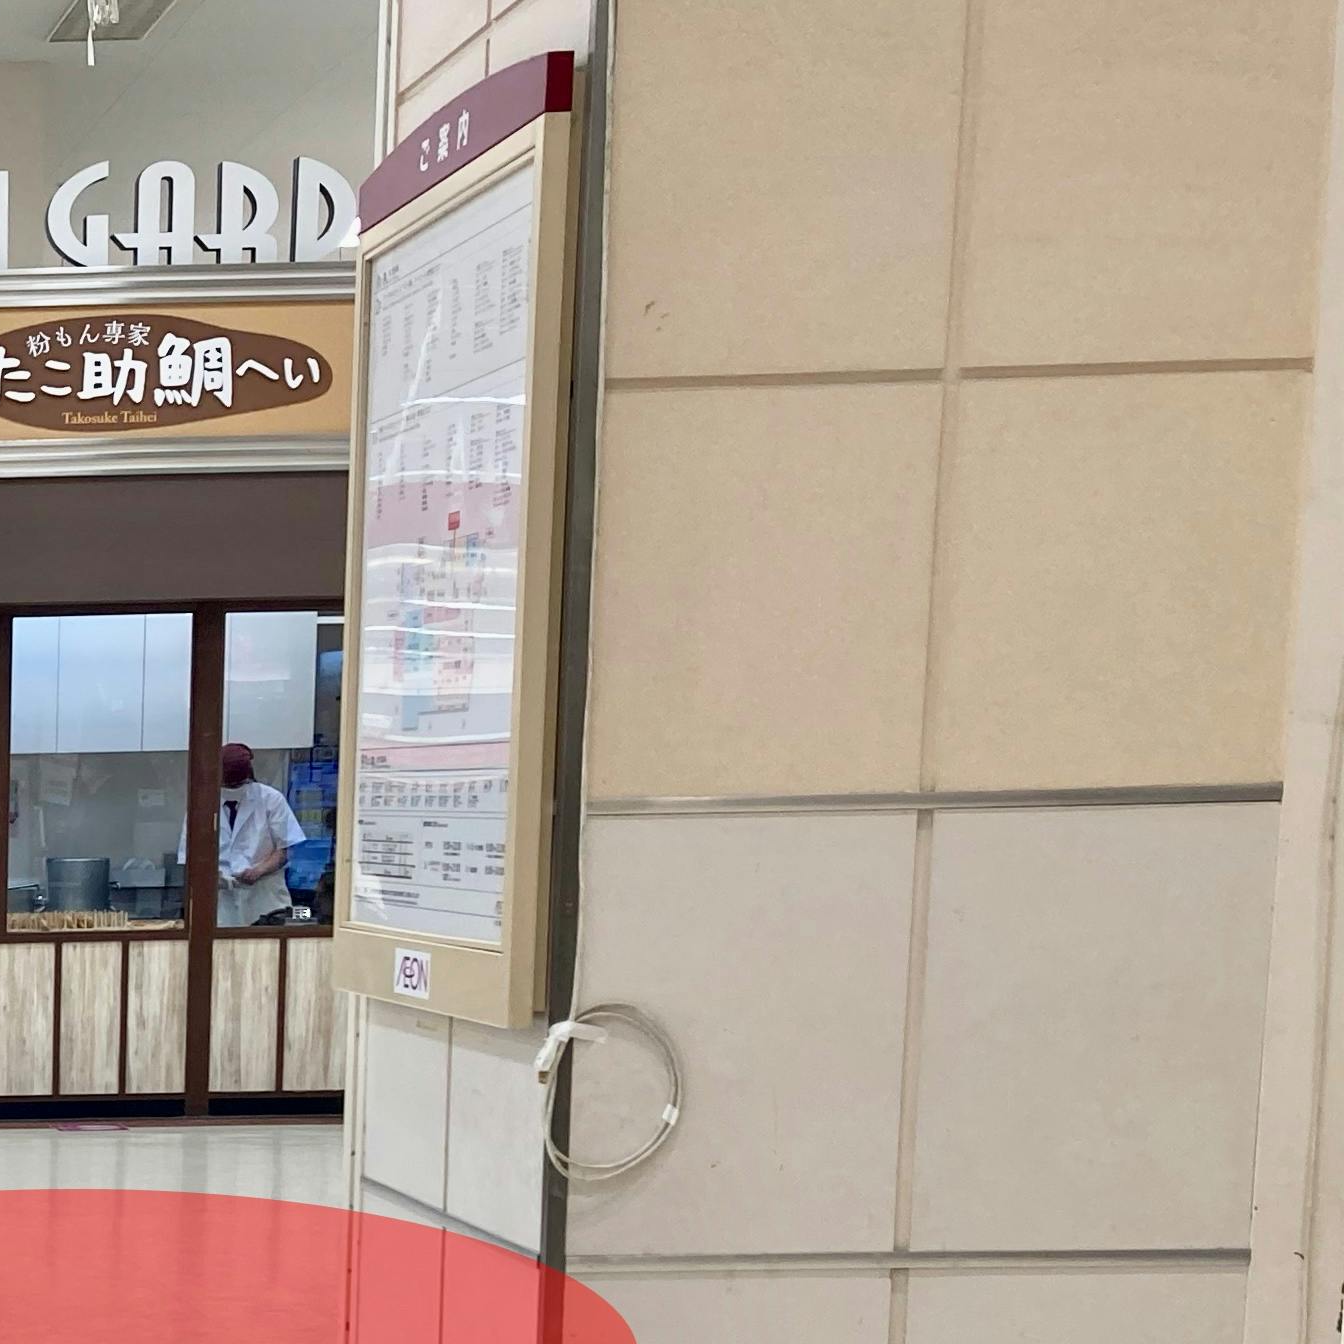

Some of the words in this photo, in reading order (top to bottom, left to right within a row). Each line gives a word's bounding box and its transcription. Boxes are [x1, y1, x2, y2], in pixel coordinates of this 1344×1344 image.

[418, 109, 471, 172] ご案内
[46, 156, 360, 268] GARD
[25, 320, 152, 358] 粉もん専家
[61, 411, 119, 426] Takosuke
